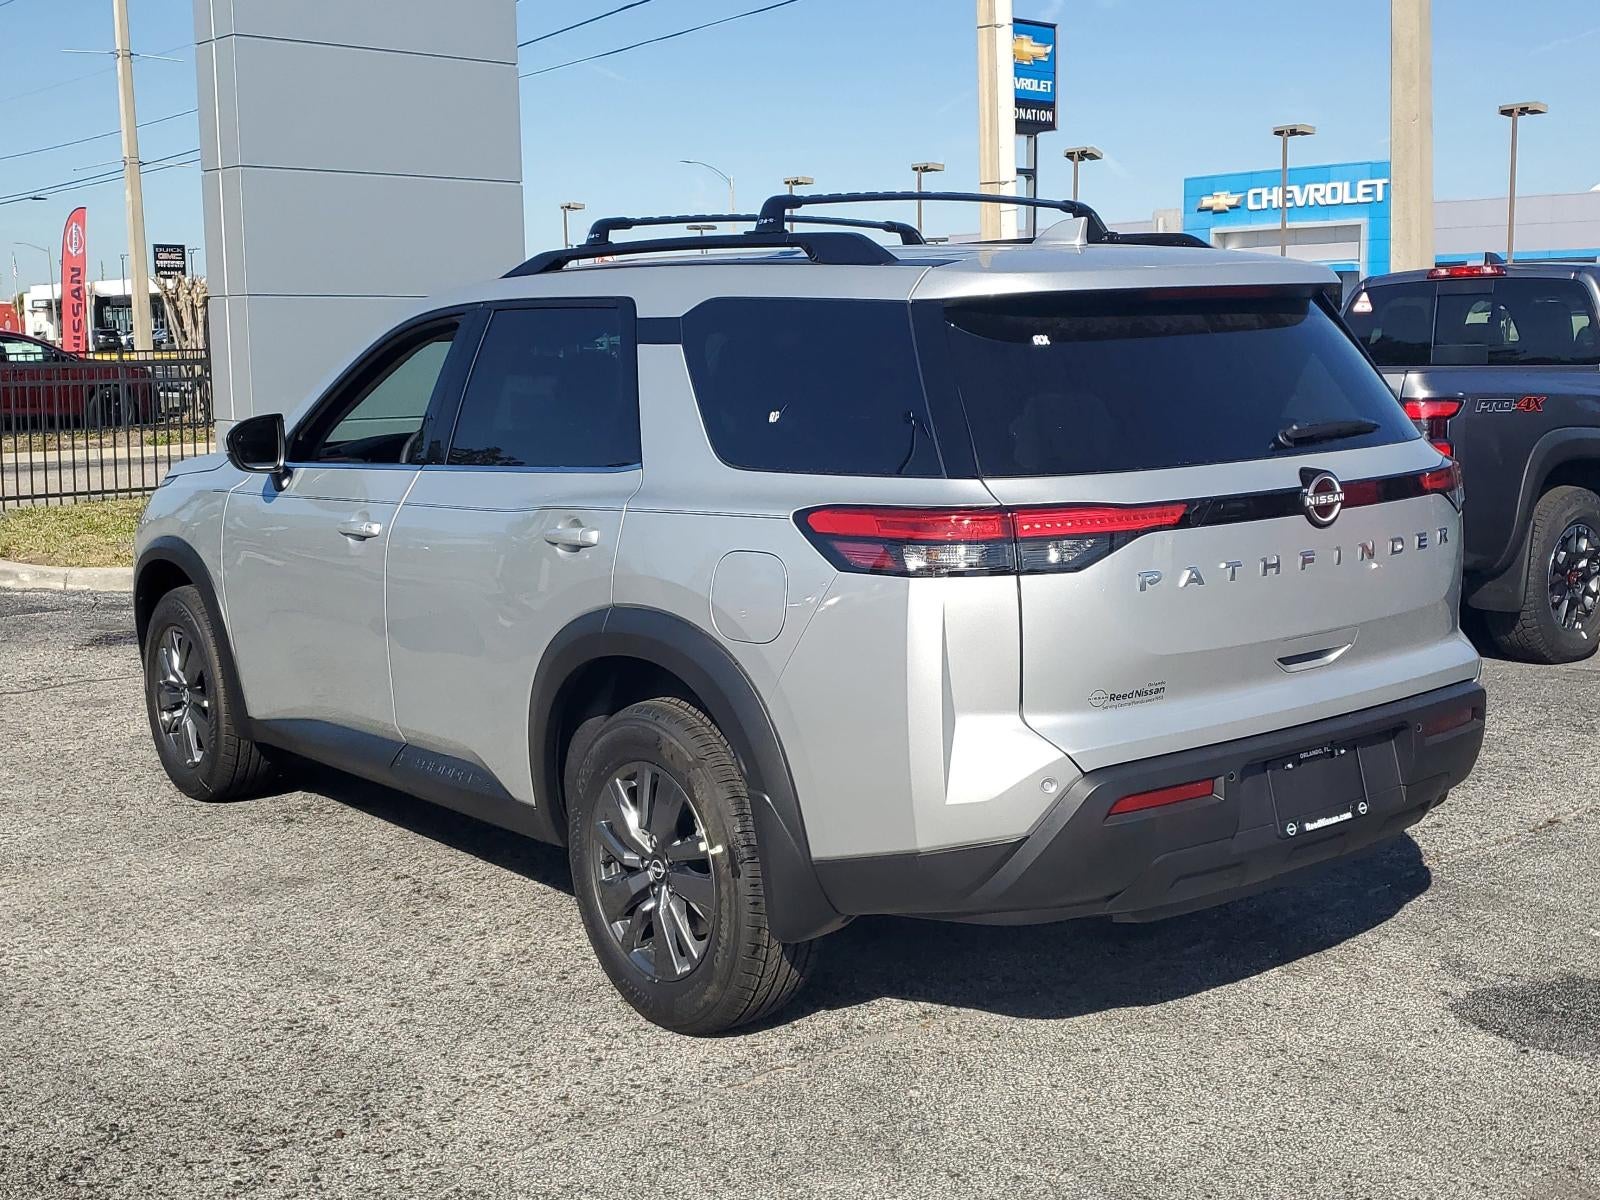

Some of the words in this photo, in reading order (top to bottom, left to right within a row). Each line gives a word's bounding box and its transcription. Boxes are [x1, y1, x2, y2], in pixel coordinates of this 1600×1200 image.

[1014, 77, 1052, 93] VROLET
[1247, 178, 1389, 211] CHEVROLET
[1306, 492, 1345, 505] NISSAN
[1136, 527, 1449, 592] PATHFINDER
[1109, 690, 1135, 702] Reed
[1134, 687, 1165, 699] Nissan
